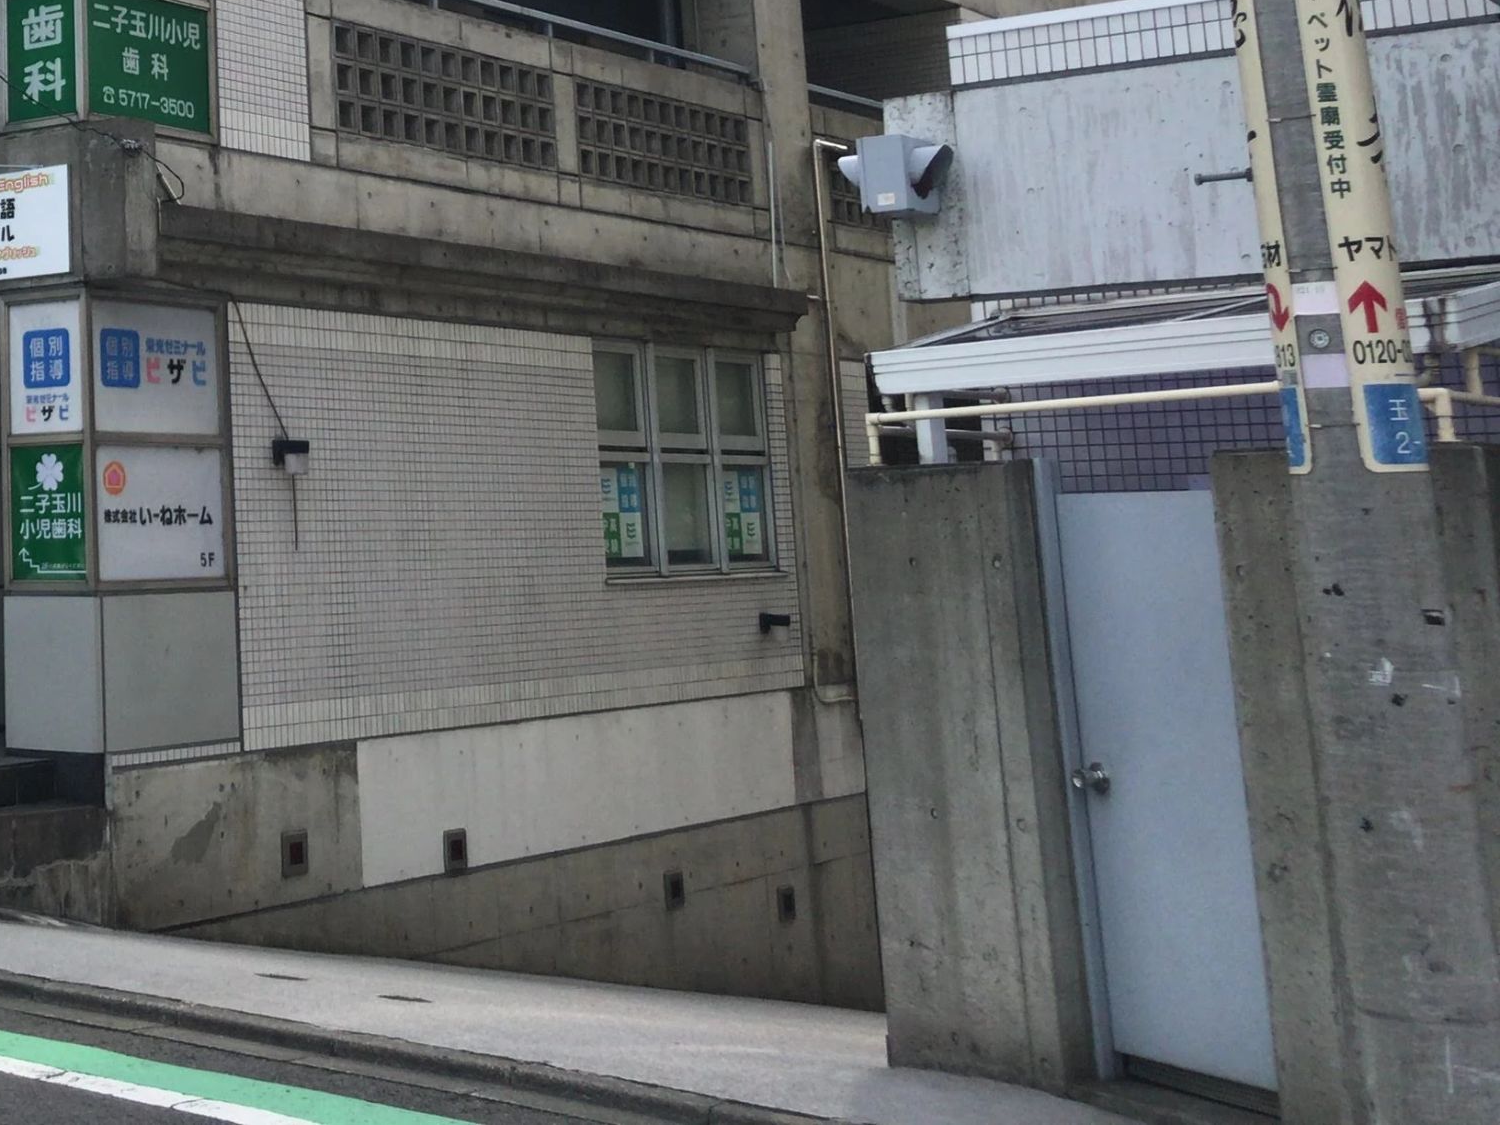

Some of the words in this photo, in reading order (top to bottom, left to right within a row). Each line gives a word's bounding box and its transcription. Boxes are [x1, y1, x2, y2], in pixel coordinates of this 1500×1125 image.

[92, 2, 201, 50] 二子玉川小児
[21, 4, 66, 105] 歯科
[122, 46, 169, 81] 歯科
[118, 89, 195, 119] 5717-3500
[30, 336, 63, 357] 個別
[30, 359, 63, 382] 指導
[1388, 399, 1409, 421] 玉
[19, 492, 82, 514] 二子玉川
[19, 518, 82, 540] 小児歯科
[200, 552, 215, 568] 5F
